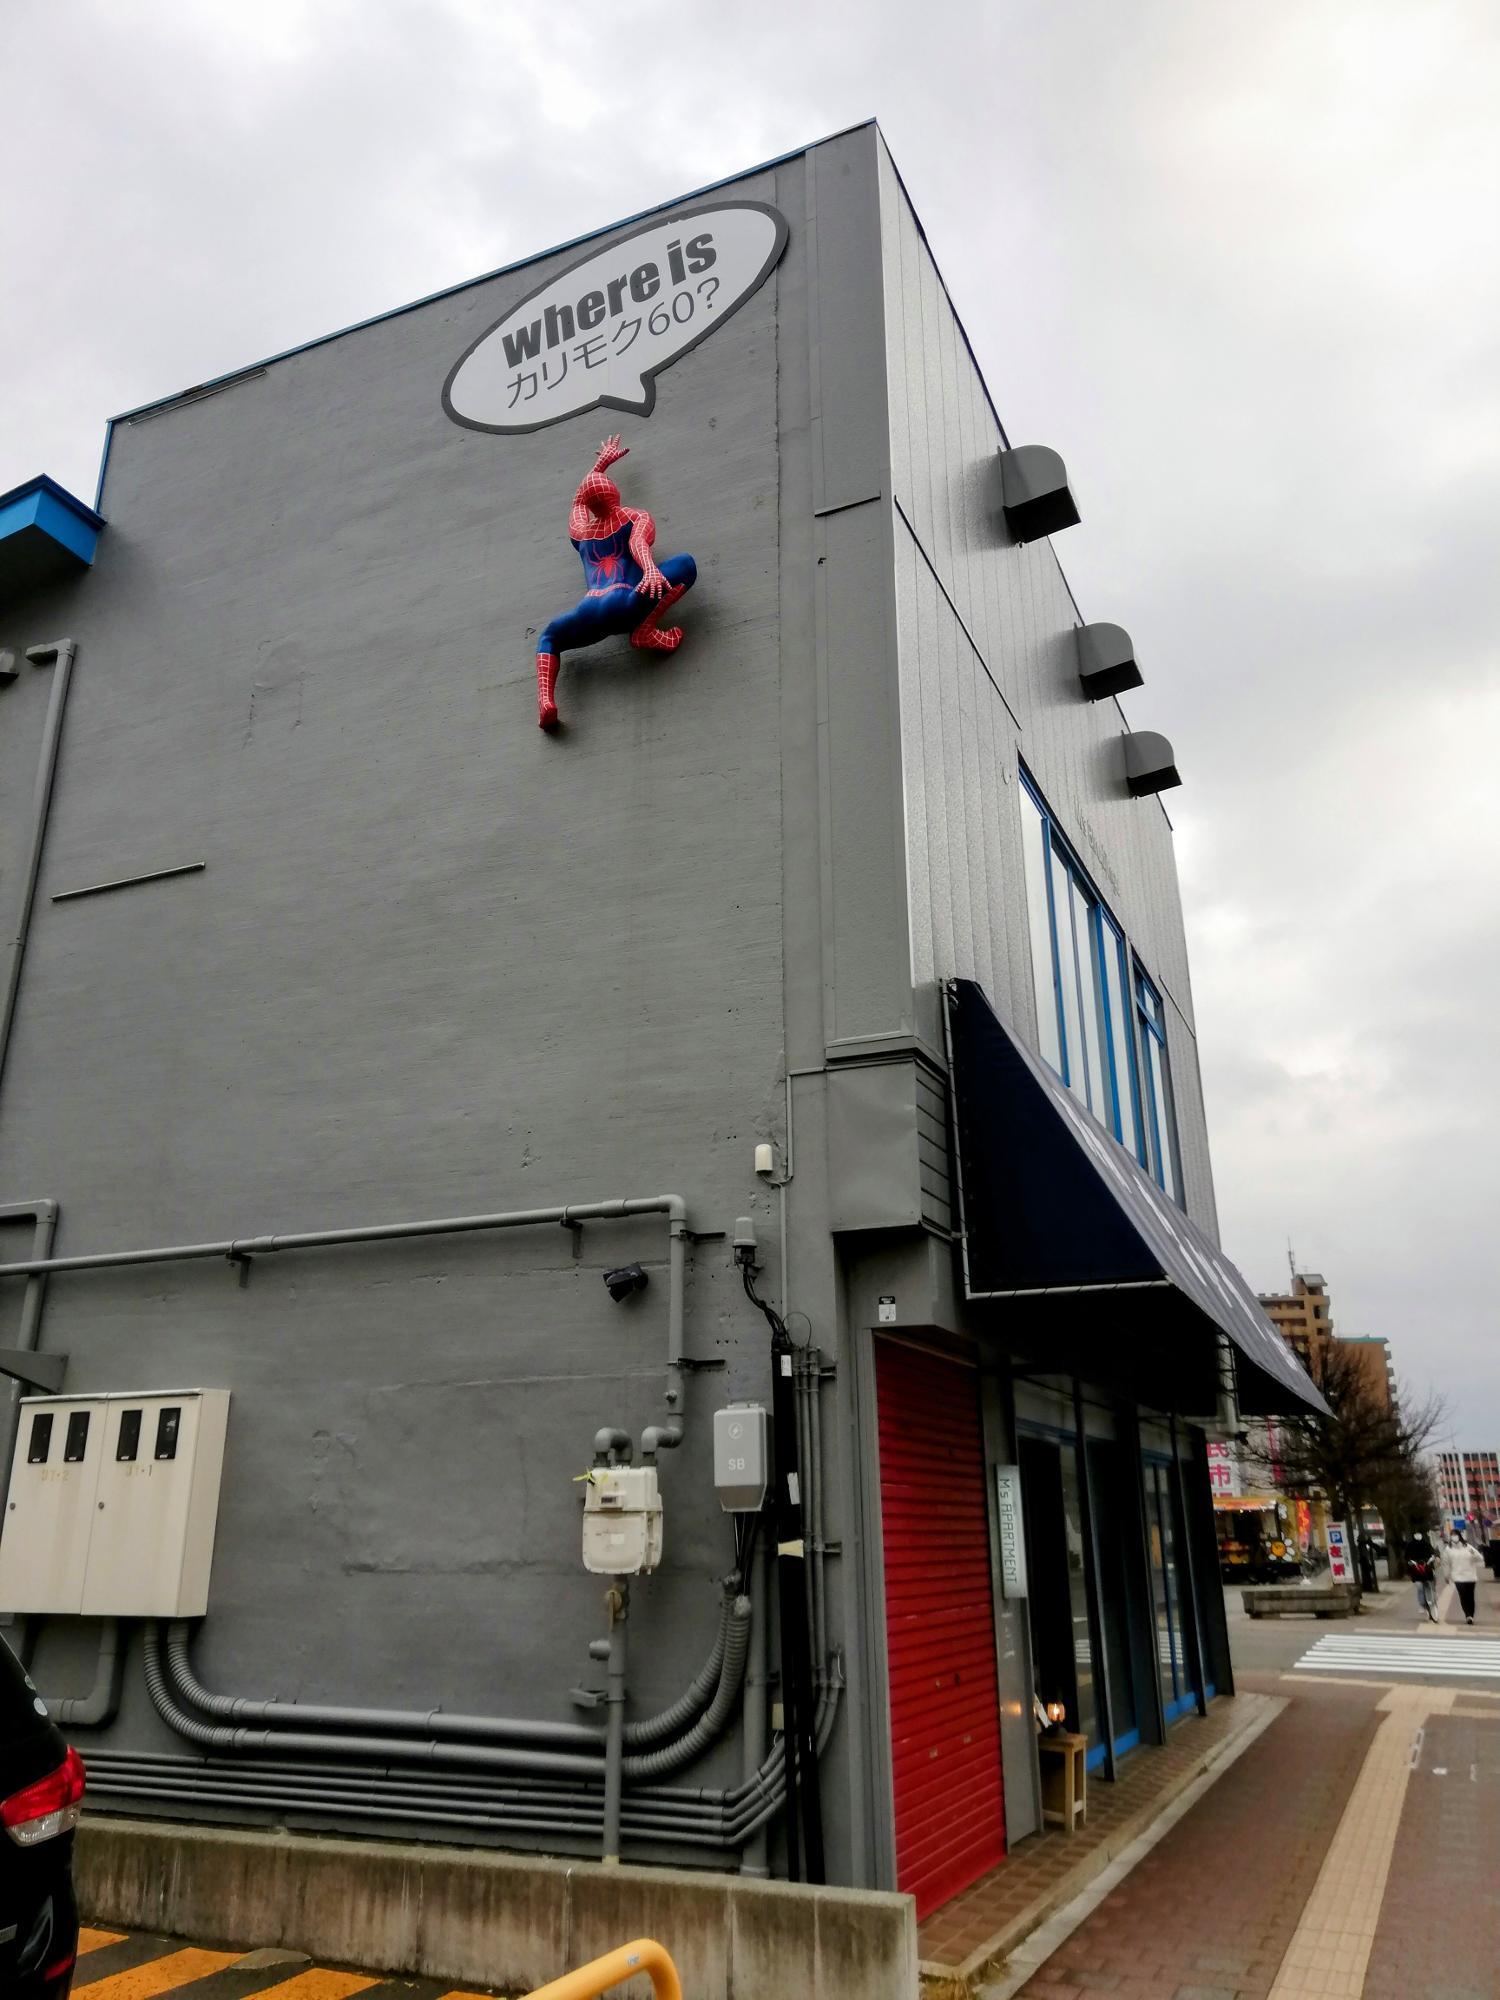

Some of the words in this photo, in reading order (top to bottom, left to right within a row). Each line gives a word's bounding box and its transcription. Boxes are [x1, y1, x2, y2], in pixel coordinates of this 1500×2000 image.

[501, 262, 660, 368] where
[666, 232, 718, 286] is
[506, 276, 721, 409] カリモク60?
[728, 1457, 745, 1471] SB
[1001, 1503, 1018, 1584] APARTMENT
